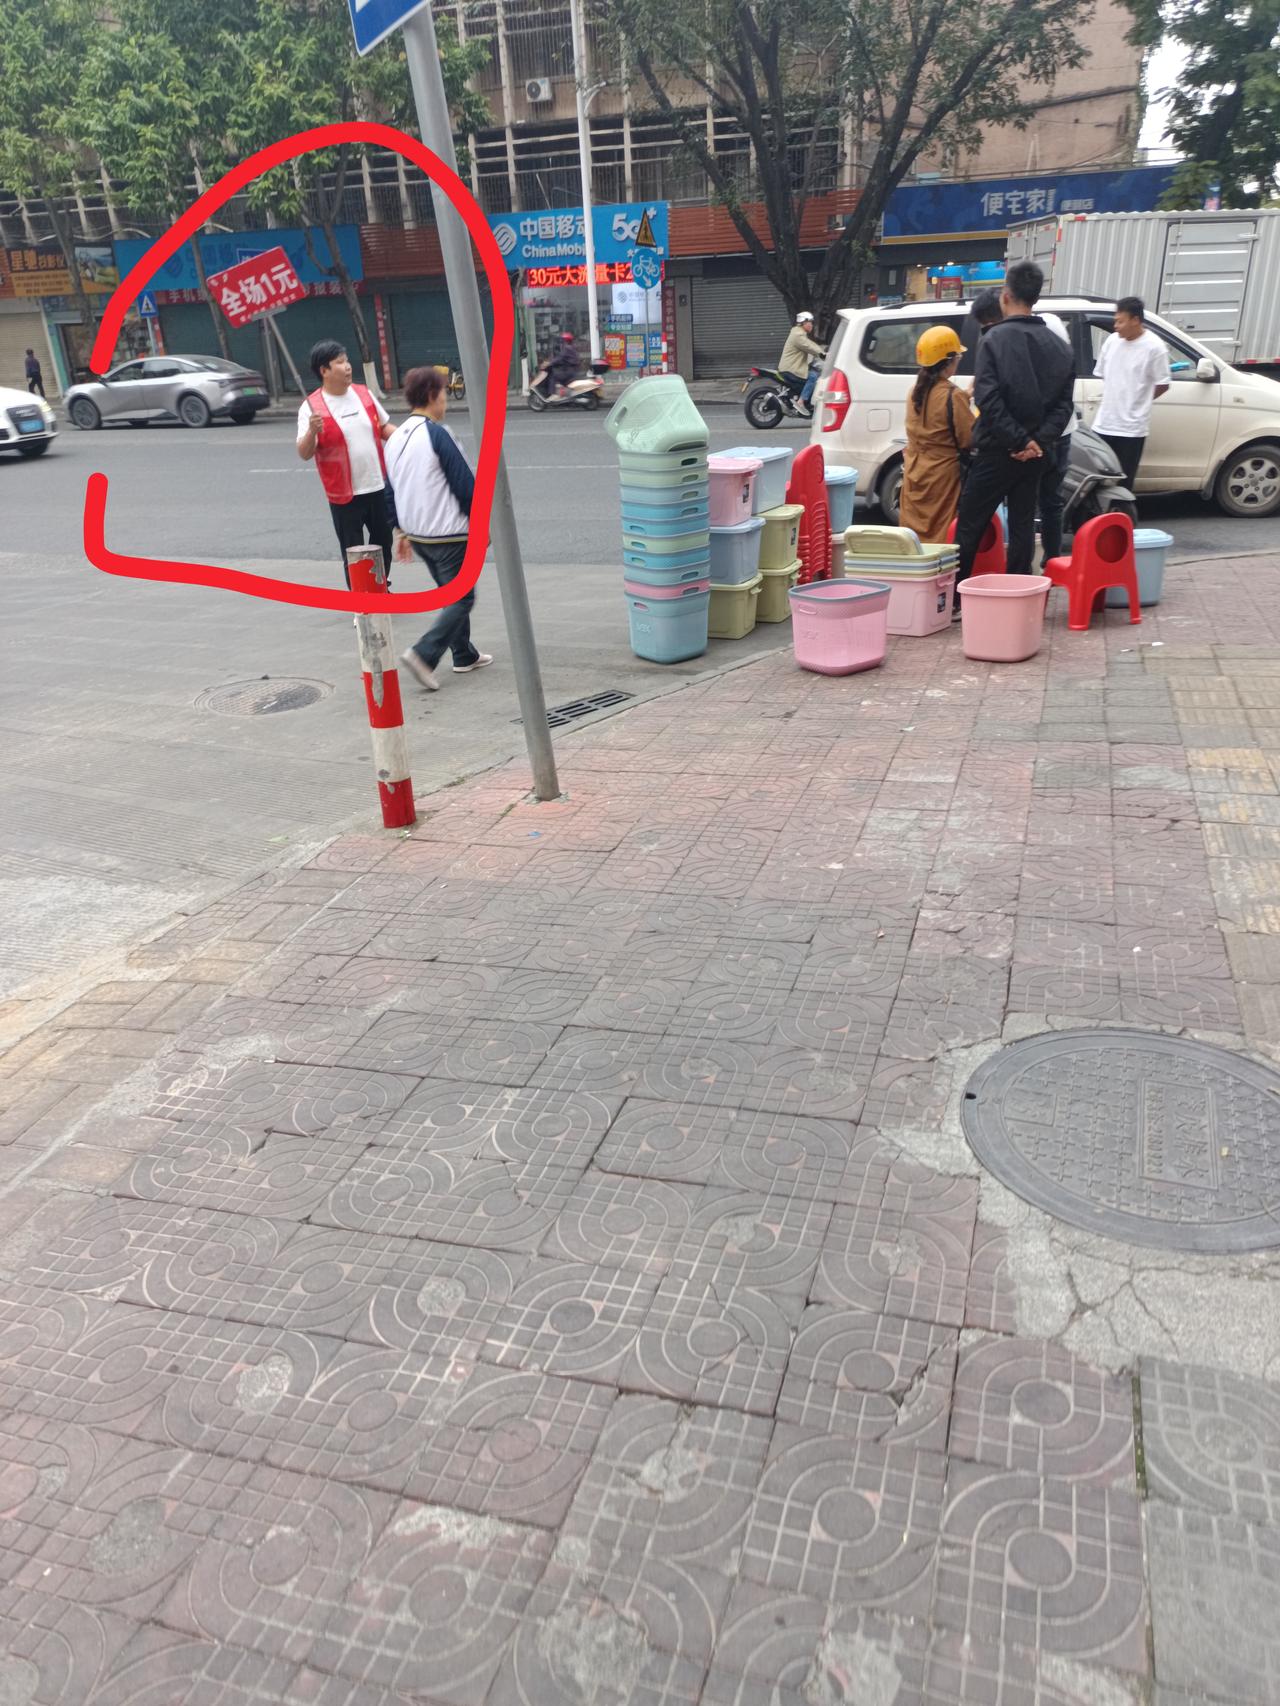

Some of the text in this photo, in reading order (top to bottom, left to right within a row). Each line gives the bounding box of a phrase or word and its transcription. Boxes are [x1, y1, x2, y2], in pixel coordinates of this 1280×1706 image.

[981, 189, 1046, 216] 便宅家
[221, 263, 299, 317] 全场1元
